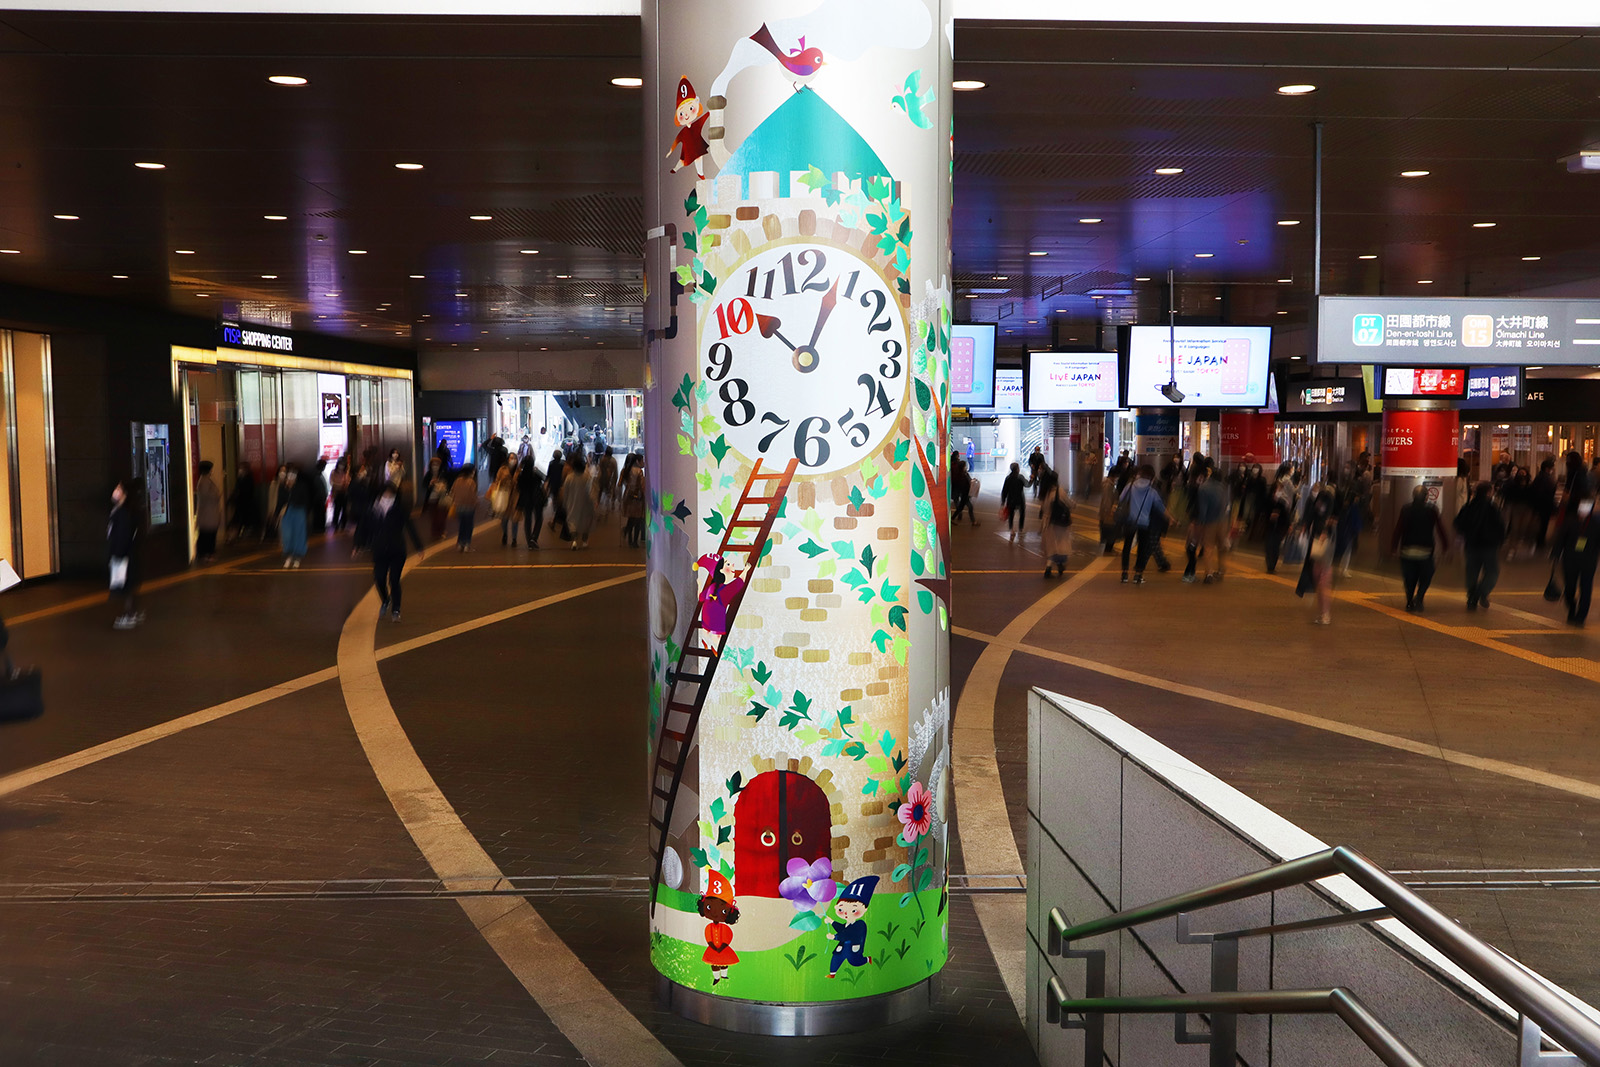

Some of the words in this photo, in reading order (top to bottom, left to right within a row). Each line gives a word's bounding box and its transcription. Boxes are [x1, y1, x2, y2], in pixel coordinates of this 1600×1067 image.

[680, 84, 688, 98] 9
[777, 248, 830, 296] 12
[745, 266, 776, 300] 11
[841, 269, 861, 300] 1
[712, 297, 755, 340] 10
[859, 289, 892, 335] 2
[1386, 314, 1452, 328] 田園都市線
[1361, 317, 1376, 327] DT
[1468, 319, 1487, 328] OM
[1496, 315, 1549, 329] 大井町線
[242, 330, 272, 349] SHOPPING
[271, 334, 293, 351] CENTER
[1358, 328, 1379, 342] 07
[1386, 330, 1435, 338] Den-en-toshi
[1436, 330, 1453, 338] Line
[1468, 329, 1488, 344] 15
[1528, 330, 1545, 338] Line
[705, 342, 733, 381] 9
[879, 339, 902, 379] 3
[1187, 355, 1229, 366] JAPAN
[1049, 373, 1069, 381] LIVE
[1070, 373, 1102, 381] JAPAN
[718, 378, 756, 427] 8
[857, 373, 897, 419] 4
[757, 411, 790, 453] 7
[837, 407, 870, 448] 5
[793, 416, 831, 467] 6
[713, 880, 722, 895] 3
[850, 883, 865, 897] 11
